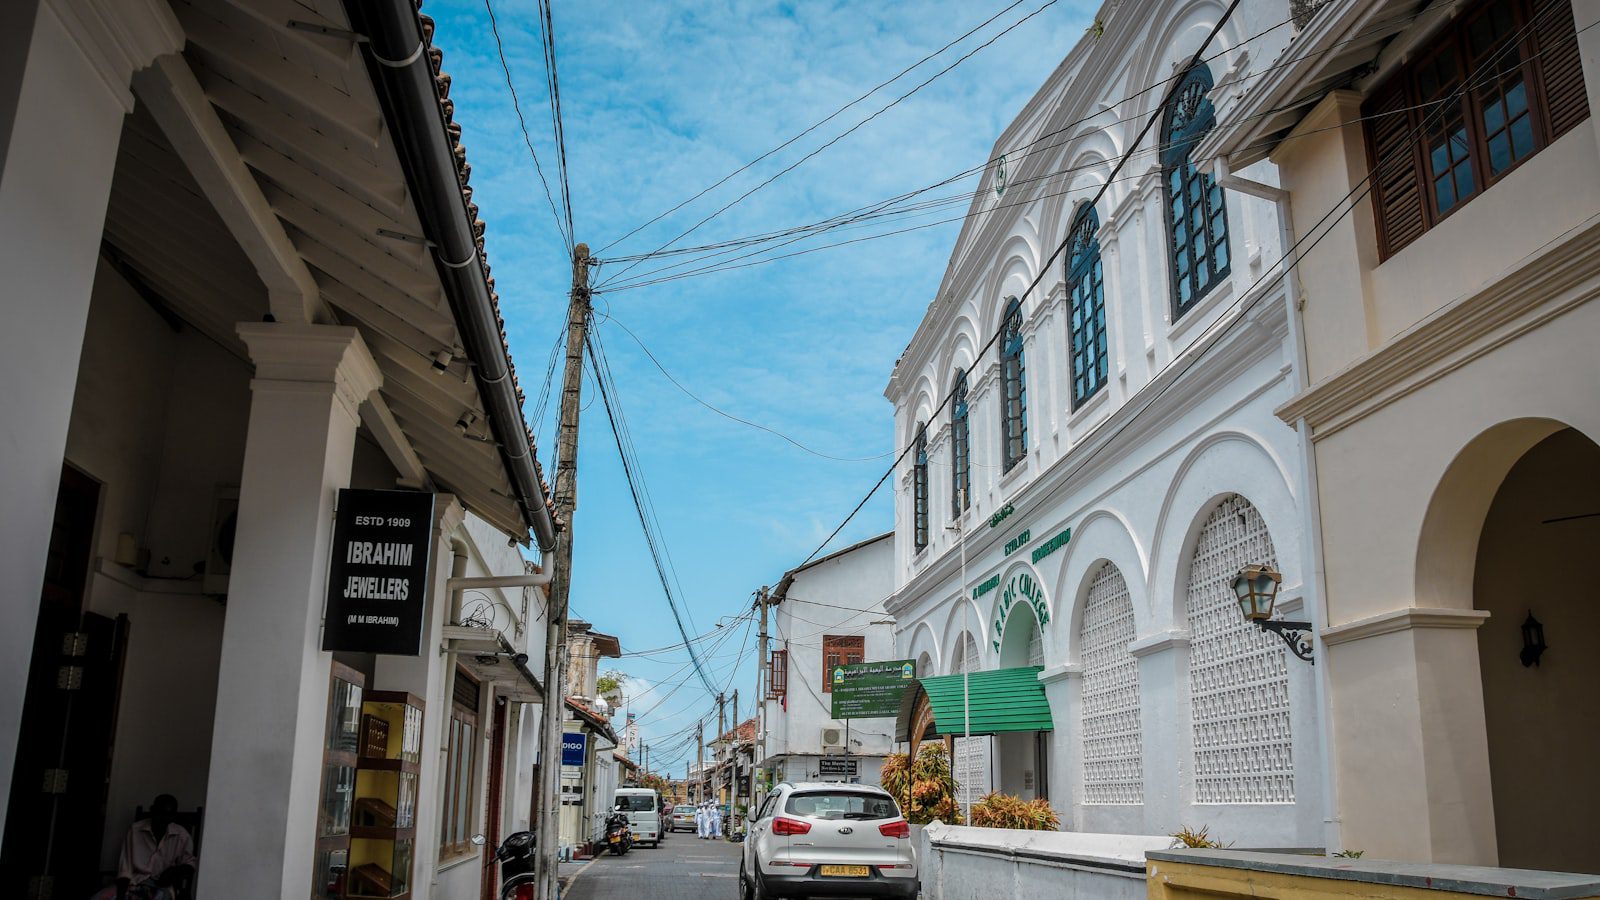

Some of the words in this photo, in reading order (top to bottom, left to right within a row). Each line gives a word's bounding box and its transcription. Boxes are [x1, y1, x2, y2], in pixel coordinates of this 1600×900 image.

[355, 516, 384, 526] ESTD
[387, 517, 411, 528] 1909
[347, 541, 414, 566] IBRAHIM
[343, 576, 410, 601] JEWELLERS
[347, 614, 356, 625] (M
[358, 615, 365, 624] M
[366, 615, 399, 627] IBRAHIM)
[992, 576, 1017, 654] ARABIC
[1019, 573, 1050, 634] COLLEGE
[830, 866, 846, 874] CAA
